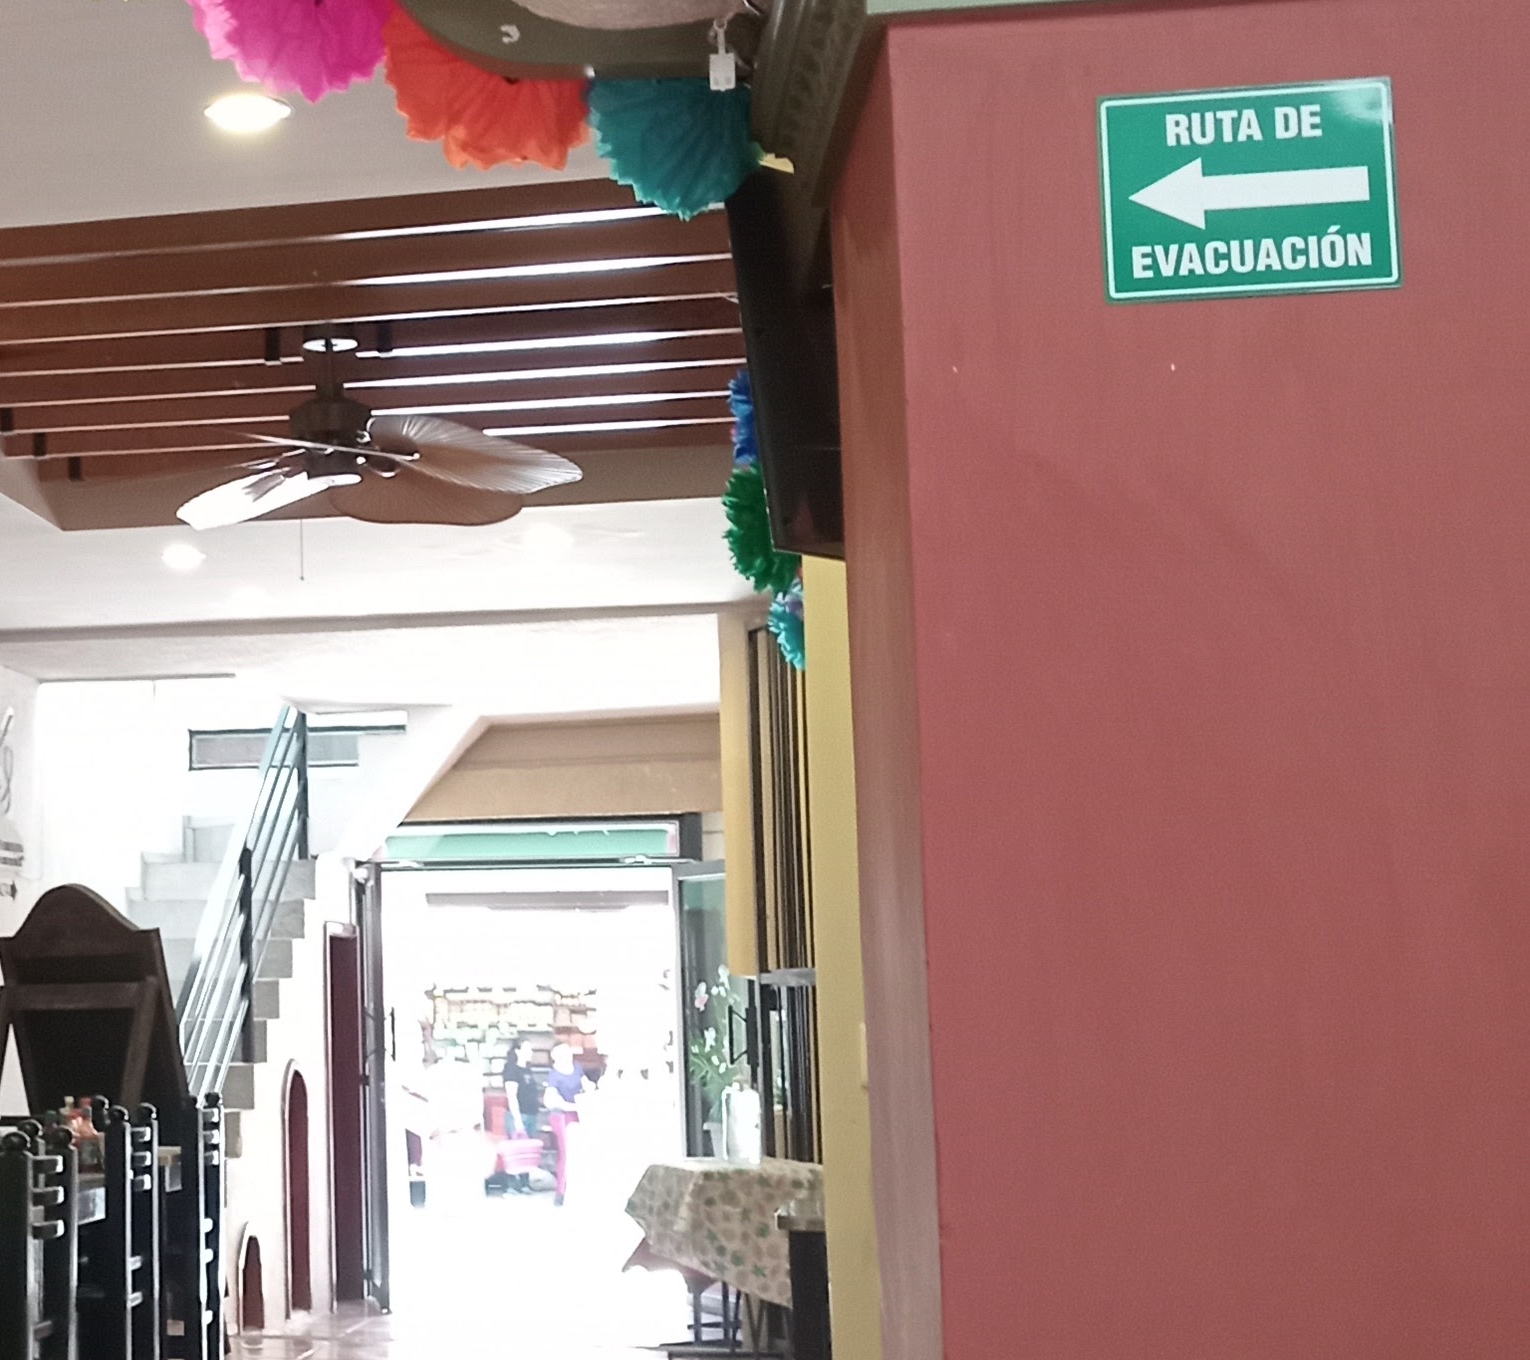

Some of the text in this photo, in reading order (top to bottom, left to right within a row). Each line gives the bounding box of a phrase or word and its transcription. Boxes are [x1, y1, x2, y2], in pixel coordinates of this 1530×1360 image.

[1165, 104, 1323, 146] RUTA DE
[1131, 224, 1373, 279] EVACUACIÓN
